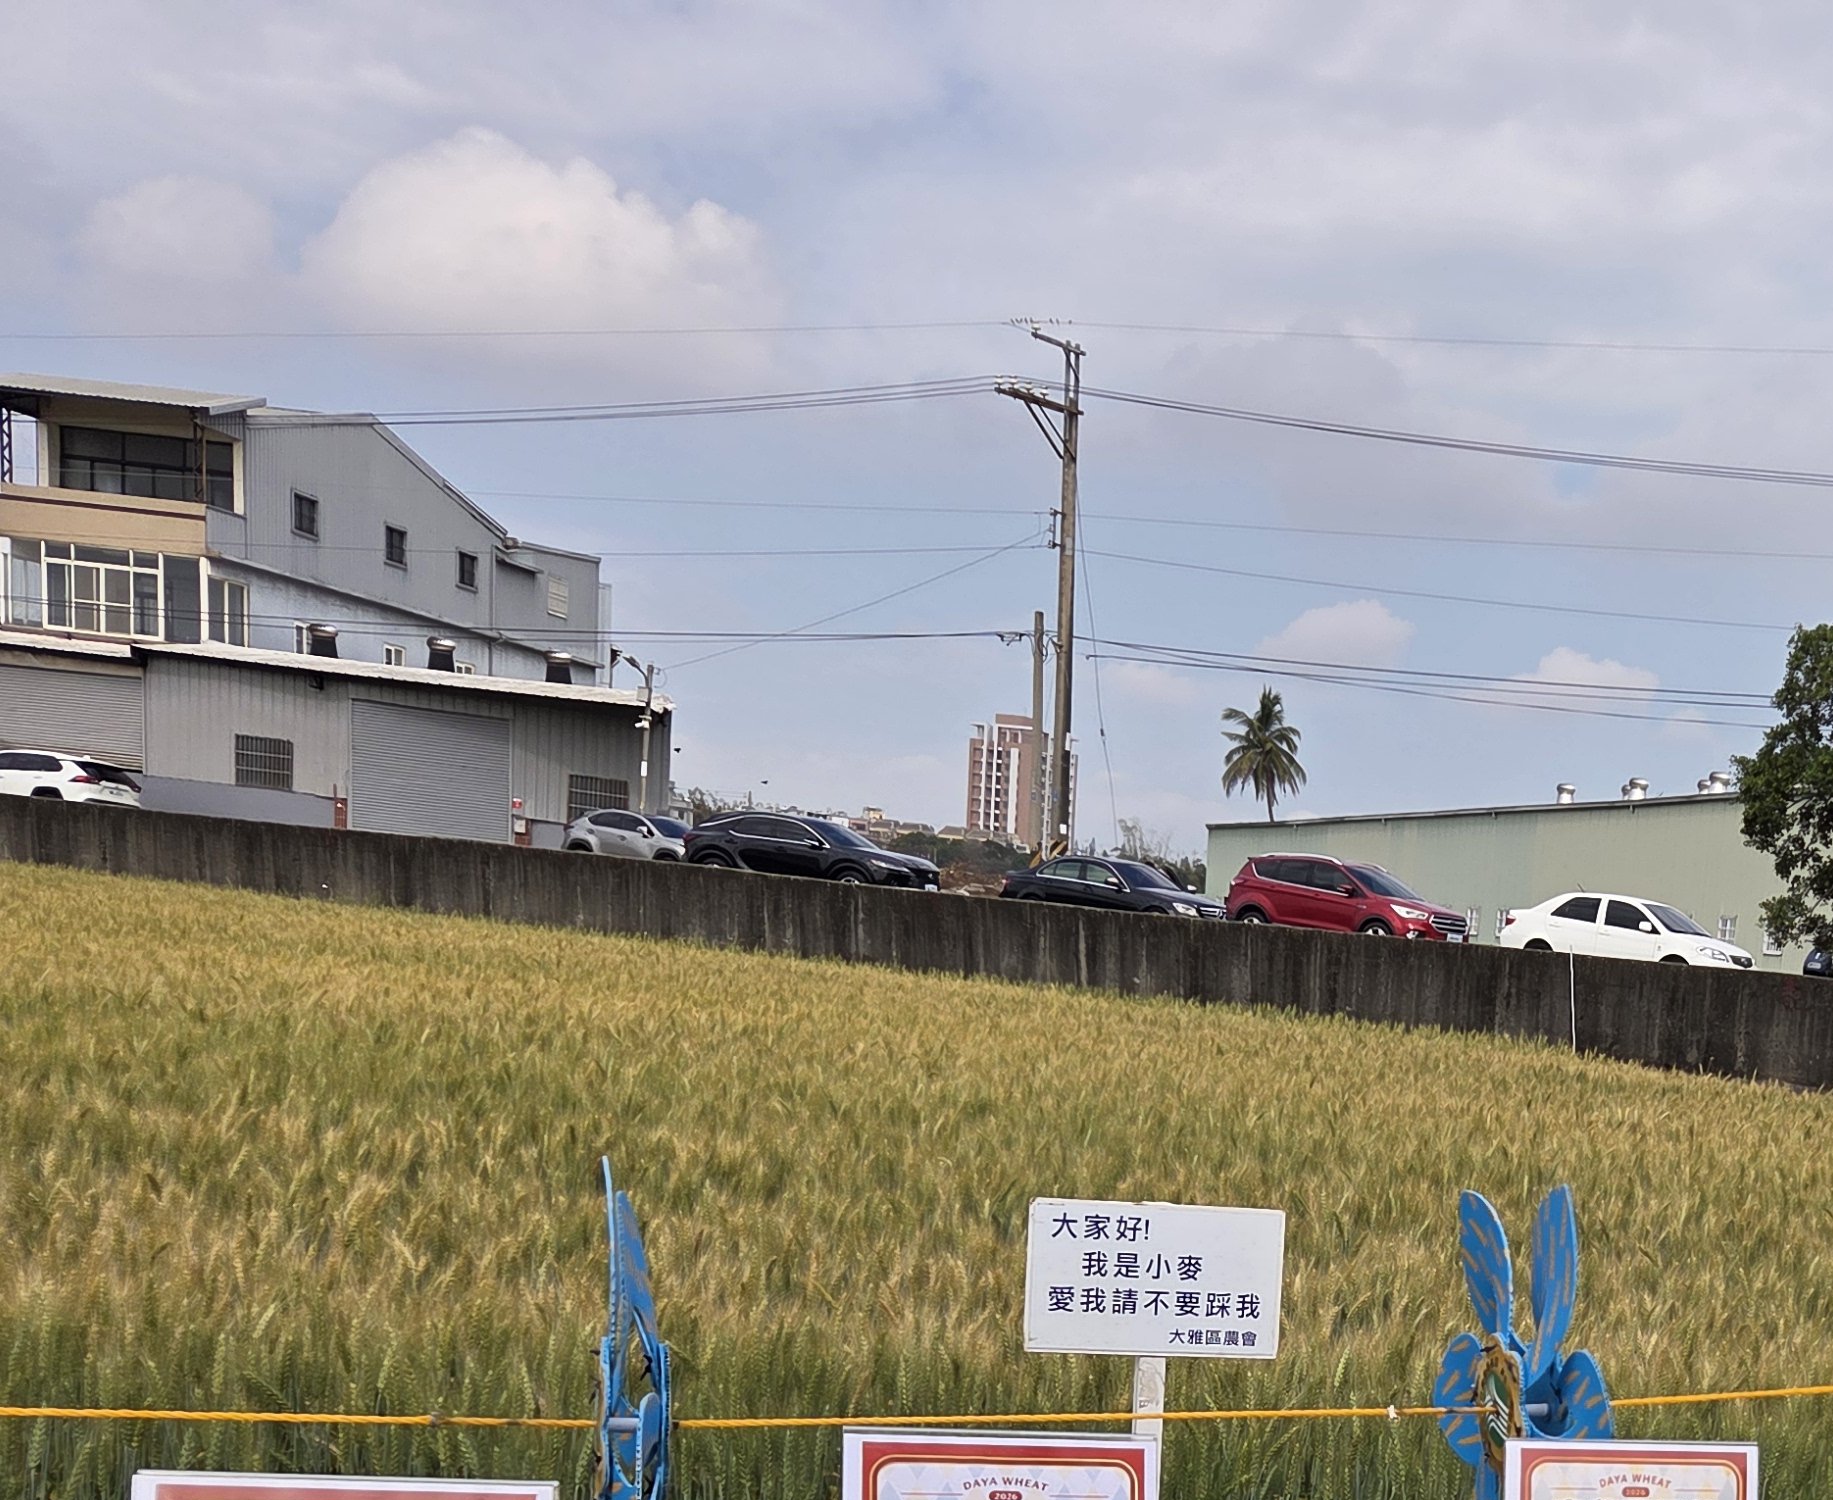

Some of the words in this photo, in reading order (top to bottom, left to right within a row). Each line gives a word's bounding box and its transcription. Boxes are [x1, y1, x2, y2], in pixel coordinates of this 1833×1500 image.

[1051, 1212, 1150, 1242] 大家好!
[1081, 1251, 1203, 1281] 我是小麥
[1048, 1285, 1261, 1320] 愛我請不要踩我
[1168, 1328, 1258, 1347] 大雅區農會
[963, 1477, 998, 1491] DAYA
[1002, 1477, 1050, 1492] WHEAT
[1599, 1474, 1628, 1489] DAYA
[1632, 1474, 1671, 1489] WHEAT
[993, 1492, 1019, 1500] 2026
